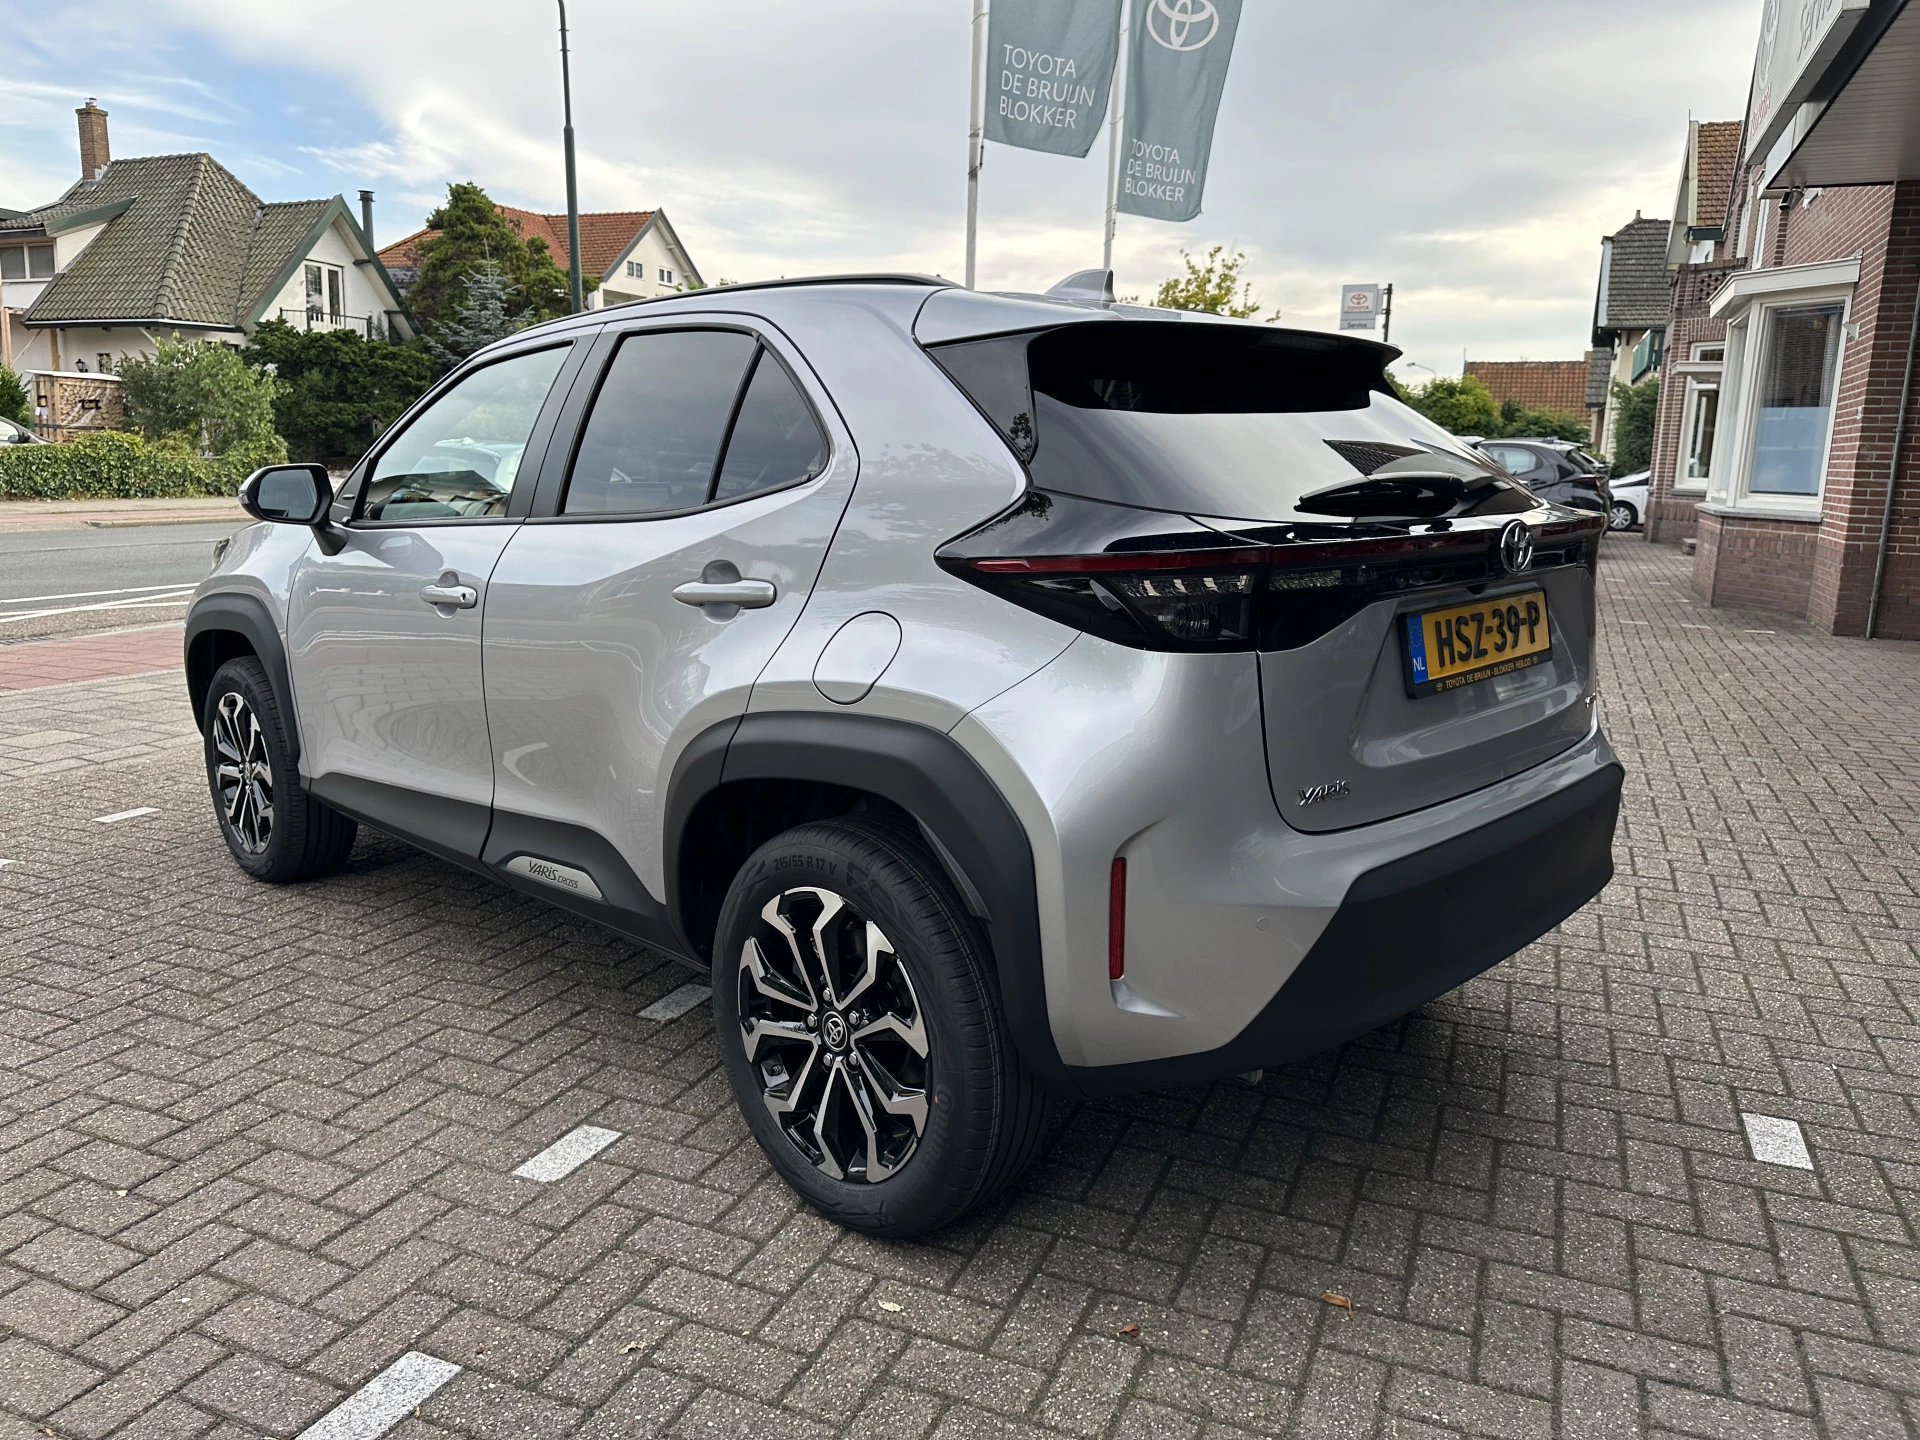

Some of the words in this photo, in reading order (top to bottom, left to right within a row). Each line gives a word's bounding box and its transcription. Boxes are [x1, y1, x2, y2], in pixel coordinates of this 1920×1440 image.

[1003, 44, 1077, 79] TOYOTA
[1001, 70, 1024, 95] DE
[1027, 78, 1096, 107] BRUIJN
[999, 95, 1077, 129] BLOKKER
[1132, 138, 1180, 164] TOYOTA
[1126, 158, 1141, 177] DE
[1145, 162, 1196, 185] BRUIJN
[1124, 177, 1185, 202] BLOKKER
[1434, 601, 1541, 668] HSZ-39-P
[1413, 656, 1426, 672] NL
[1445, 677, 1466, 689] TOYOTA
[1494, 662, 1515, 676] BLOKKER
[773, 852, 804, 872] 215/55
[806, 855, 814, 869] R
[815, 857, 826, 871] 17
[829, 861, 837, 875] V
